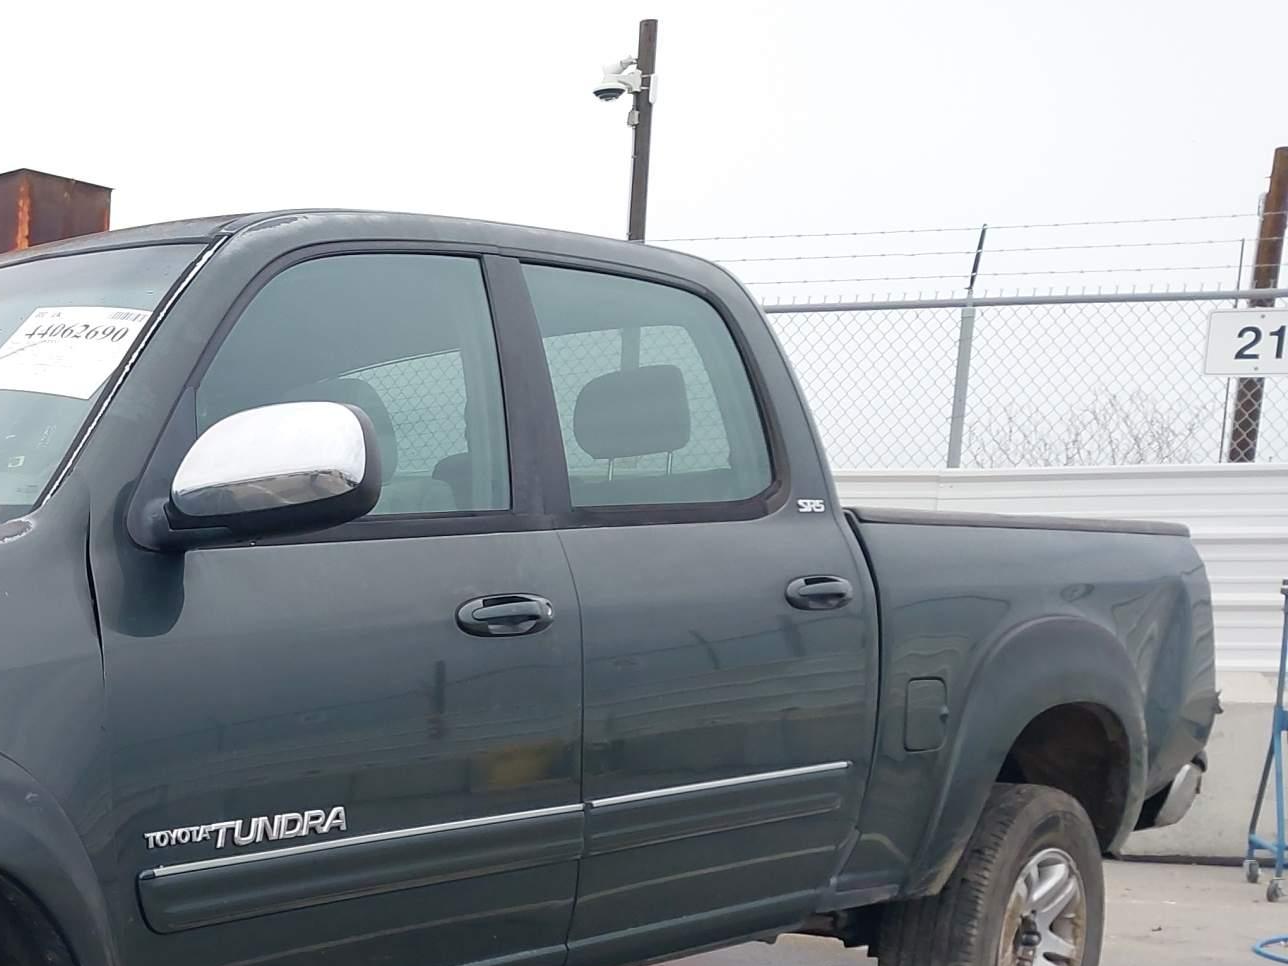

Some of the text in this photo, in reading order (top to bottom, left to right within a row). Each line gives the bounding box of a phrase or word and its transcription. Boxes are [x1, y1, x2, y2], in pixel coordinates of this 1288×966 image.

[1233, 325, 1286, 360] 21
[144, 806, 347, 849] TOYOTA TUNDRA
